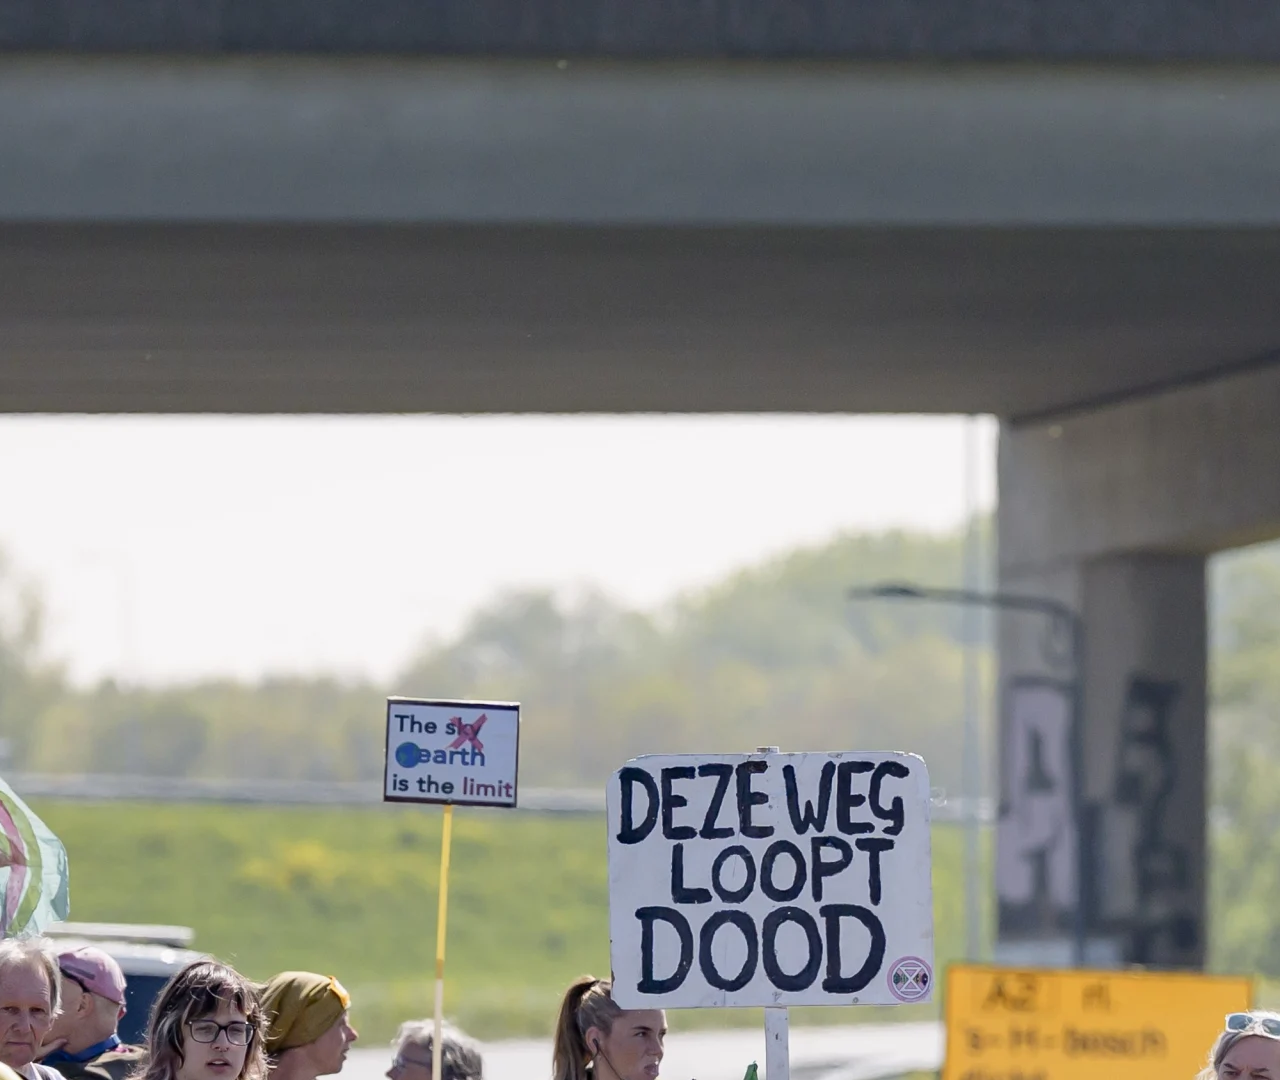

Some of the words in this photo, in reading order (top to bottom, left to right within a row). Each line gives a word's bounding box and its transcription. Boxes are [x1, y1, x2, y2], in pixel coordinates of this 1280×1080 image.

[395, 714, 437, 734] The
[420, 745, 485, 766] earth
[392, 774, 409, 791] is
[416, 775, 454, 794] the
[463, 777, 513, 798] limit
[617, 761, 774, 844] DEZE
[783, 761, 909, 836] WEG
[672, 836, 894, 906] LOOPT
[635, 904, 886, 994] DOOD
